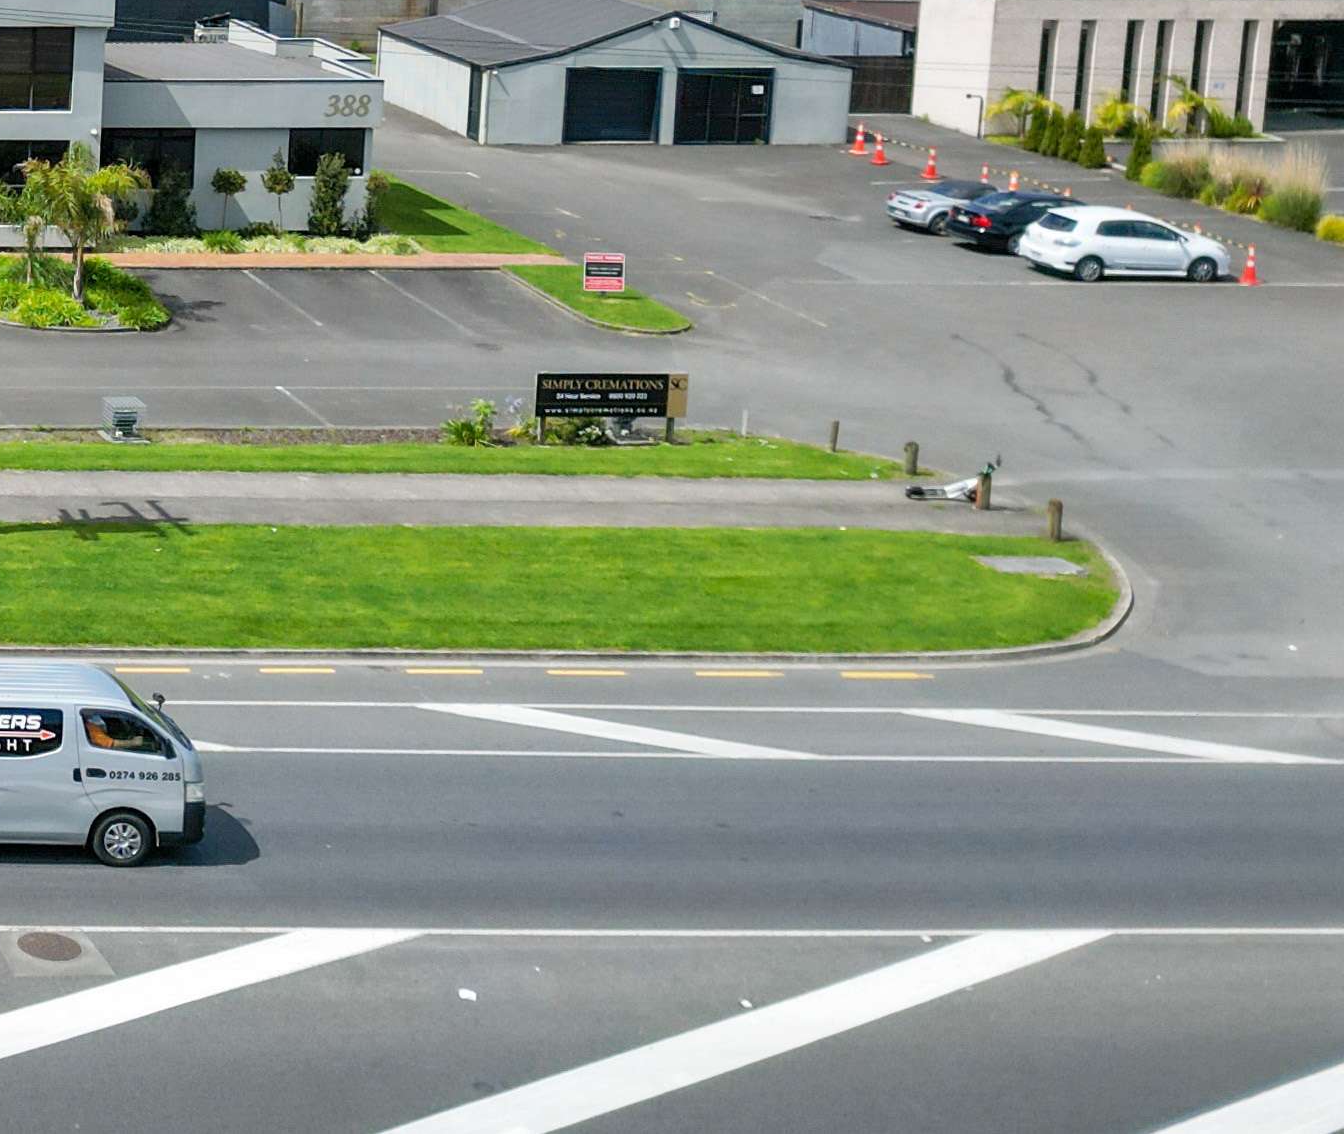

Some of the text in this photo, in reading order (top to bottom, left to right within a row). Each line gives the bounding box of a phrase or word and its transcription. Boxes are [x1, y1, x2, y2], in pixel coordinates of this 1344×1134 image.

[324, 94, 372, 117] 388
[542, 378, 663, 390] SIMPLY CREMATIONS
[670, 377, 688, 391] SC
[109, 770, 181, 781] 0274 926 285
